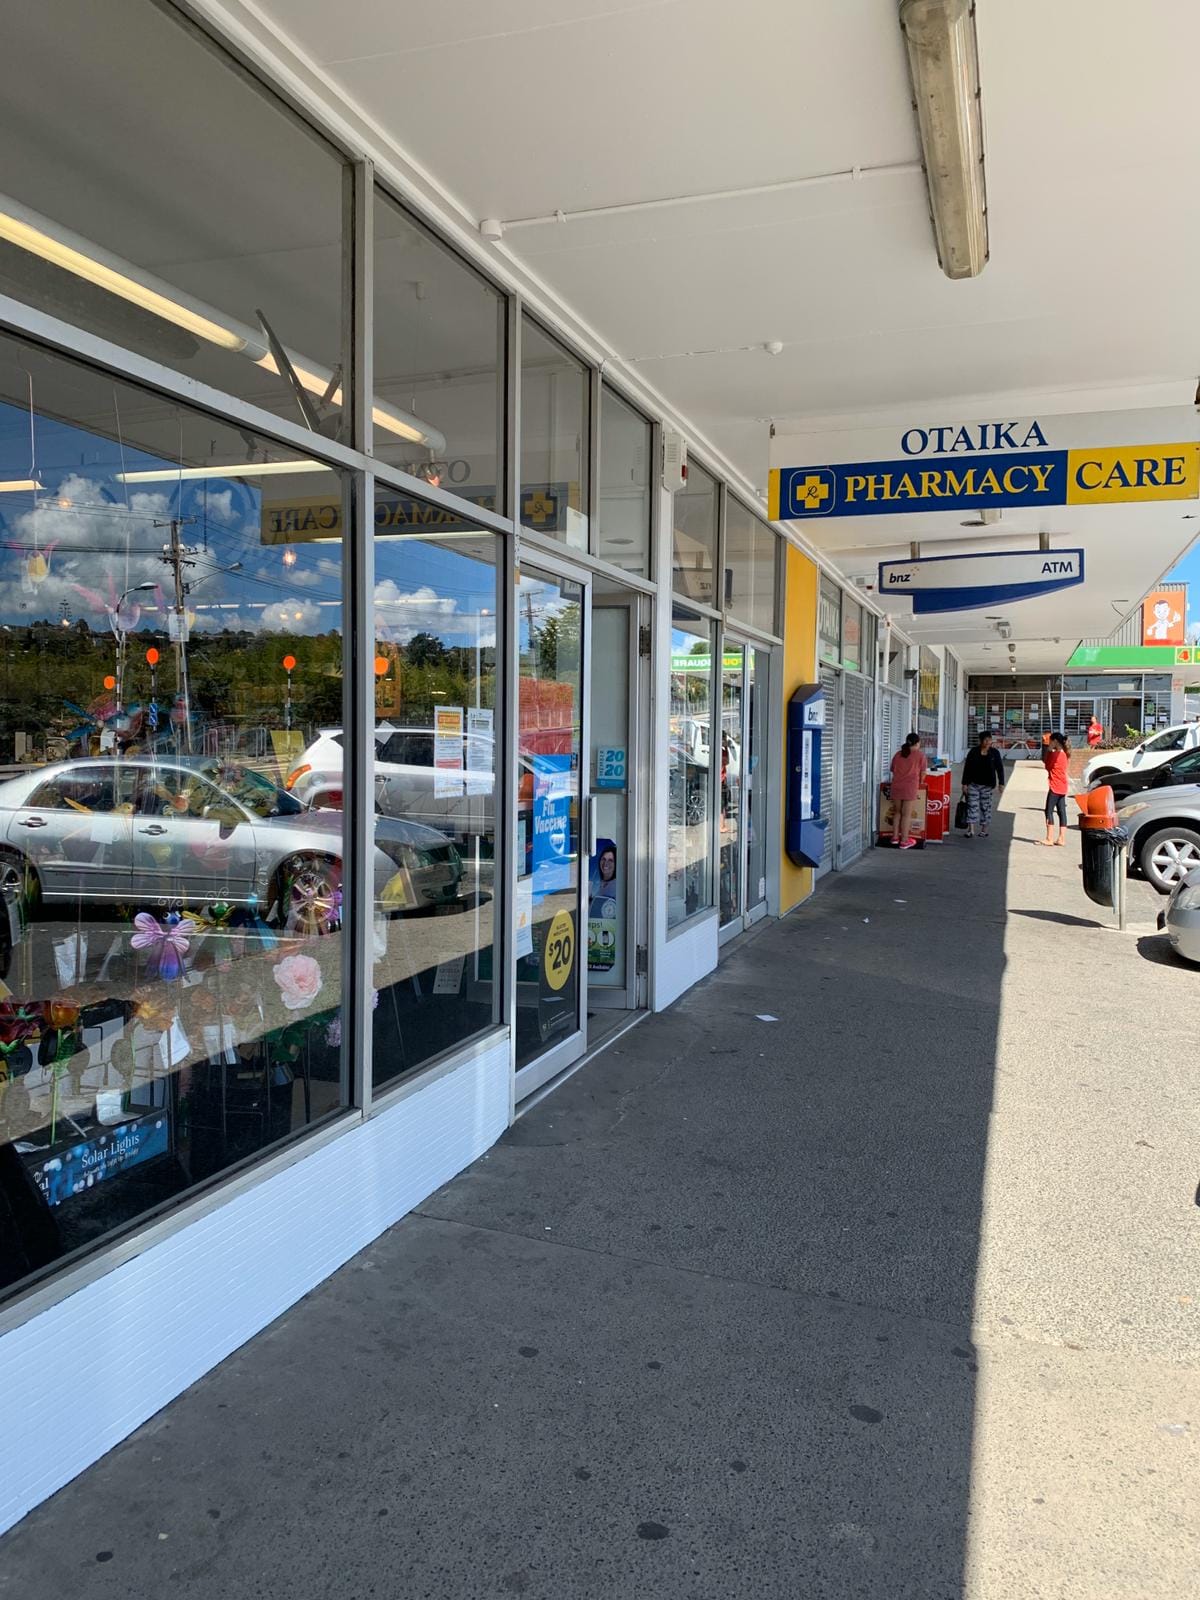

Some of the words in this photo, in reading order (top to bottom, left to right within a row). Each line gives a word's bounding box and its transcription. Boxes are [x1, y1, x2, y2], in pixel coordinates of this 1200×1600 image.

[900, 420, 1049, 456] OTAIKA
[843, 463, 1056, 503] PHARMACY
[1074, 456, 1187, 492] CARE
[1041, 560, 1074, 575] ATM
[888, 573, 911, 584] bnz
[1177, 649, 1190, 662] 4
[605, 750, 625, 762] 20
[604, 764, 625, 776] 20
[535, 815, 567, 835] Vaccine
[548, 935, 571, 971] $20
[81, 1148, 109, 1168] Solar
[111, 1134, 140, 1155] Lights
